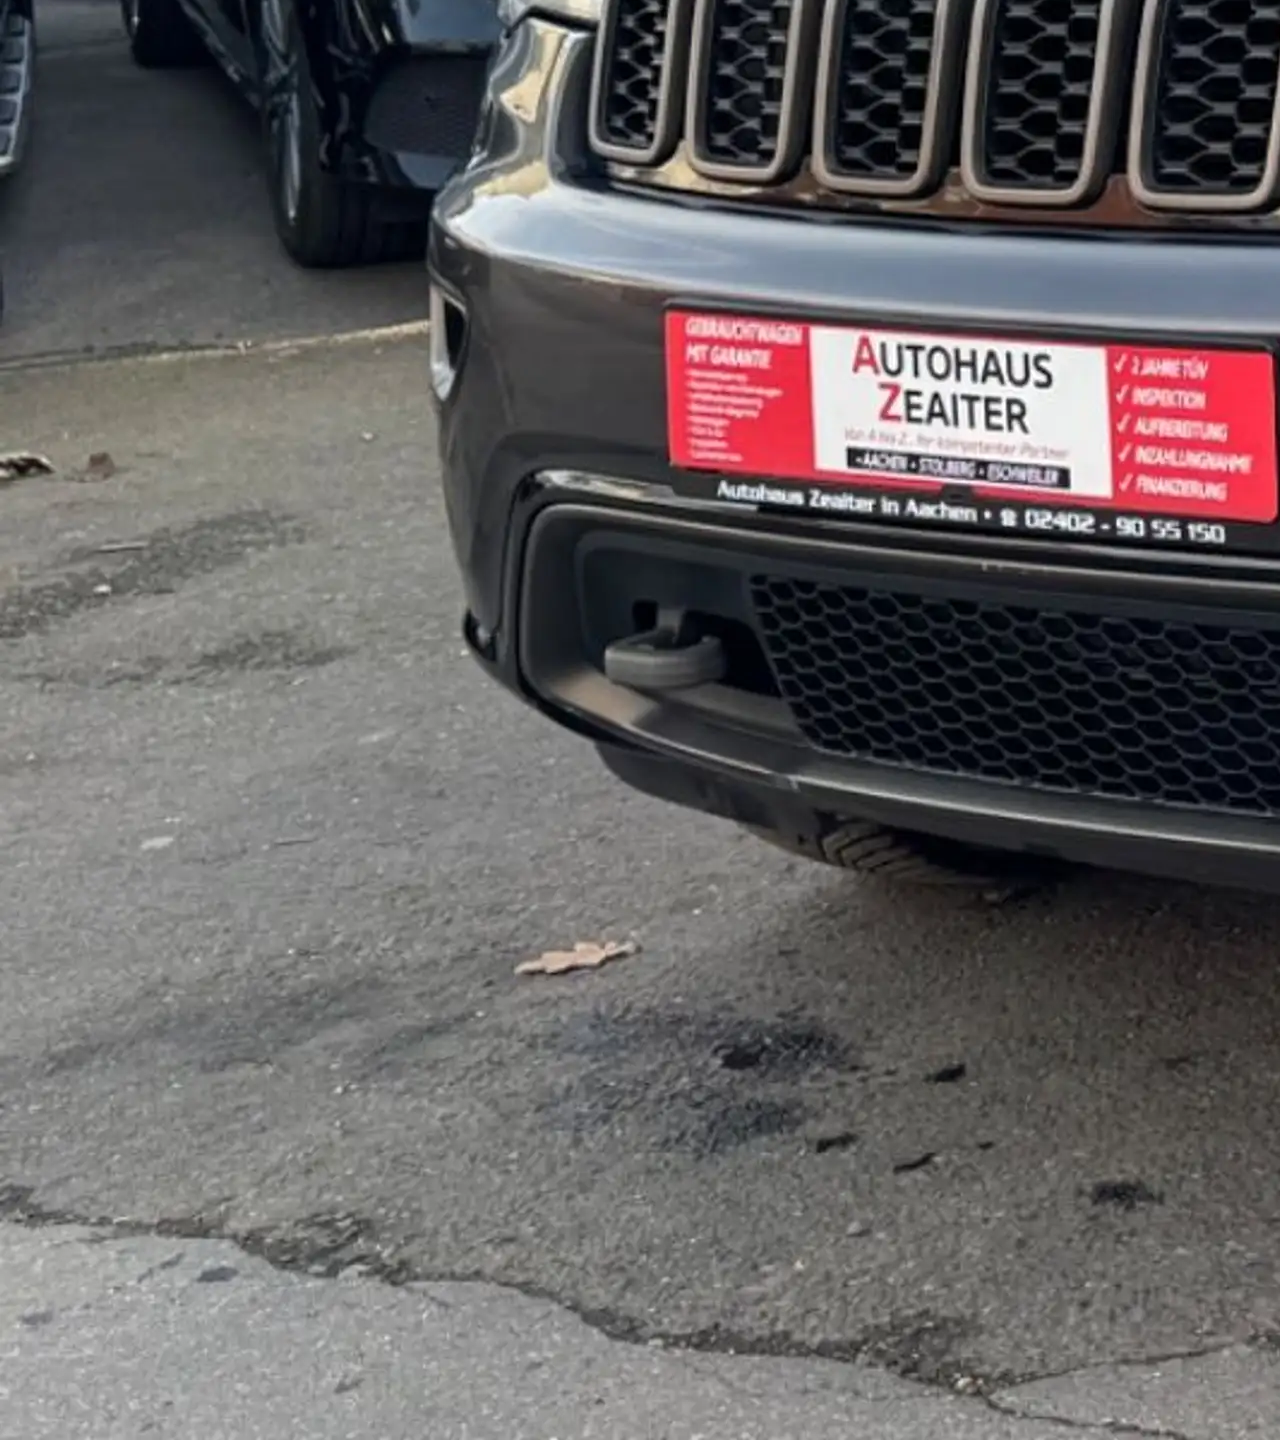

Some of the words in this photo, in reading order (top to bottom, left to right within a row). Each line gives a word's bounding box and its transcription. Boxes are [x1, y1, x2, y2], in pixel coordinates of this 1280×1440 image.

[852, 335, 1054, 390] AUTOHAUS
[878, 382, 1030, 435] ZEAITER
[716, 479, 804, 507] Autohaus
[808, 488, 877, 515] Zeaiter
[881, 496, 900, 516] in
[905, 498, 978, 524] Aachen
[1025, 508, 1096, 534] 02402
[1116, 516, 1145, 539] 90
[1186, 522, 1226, 546] 150
